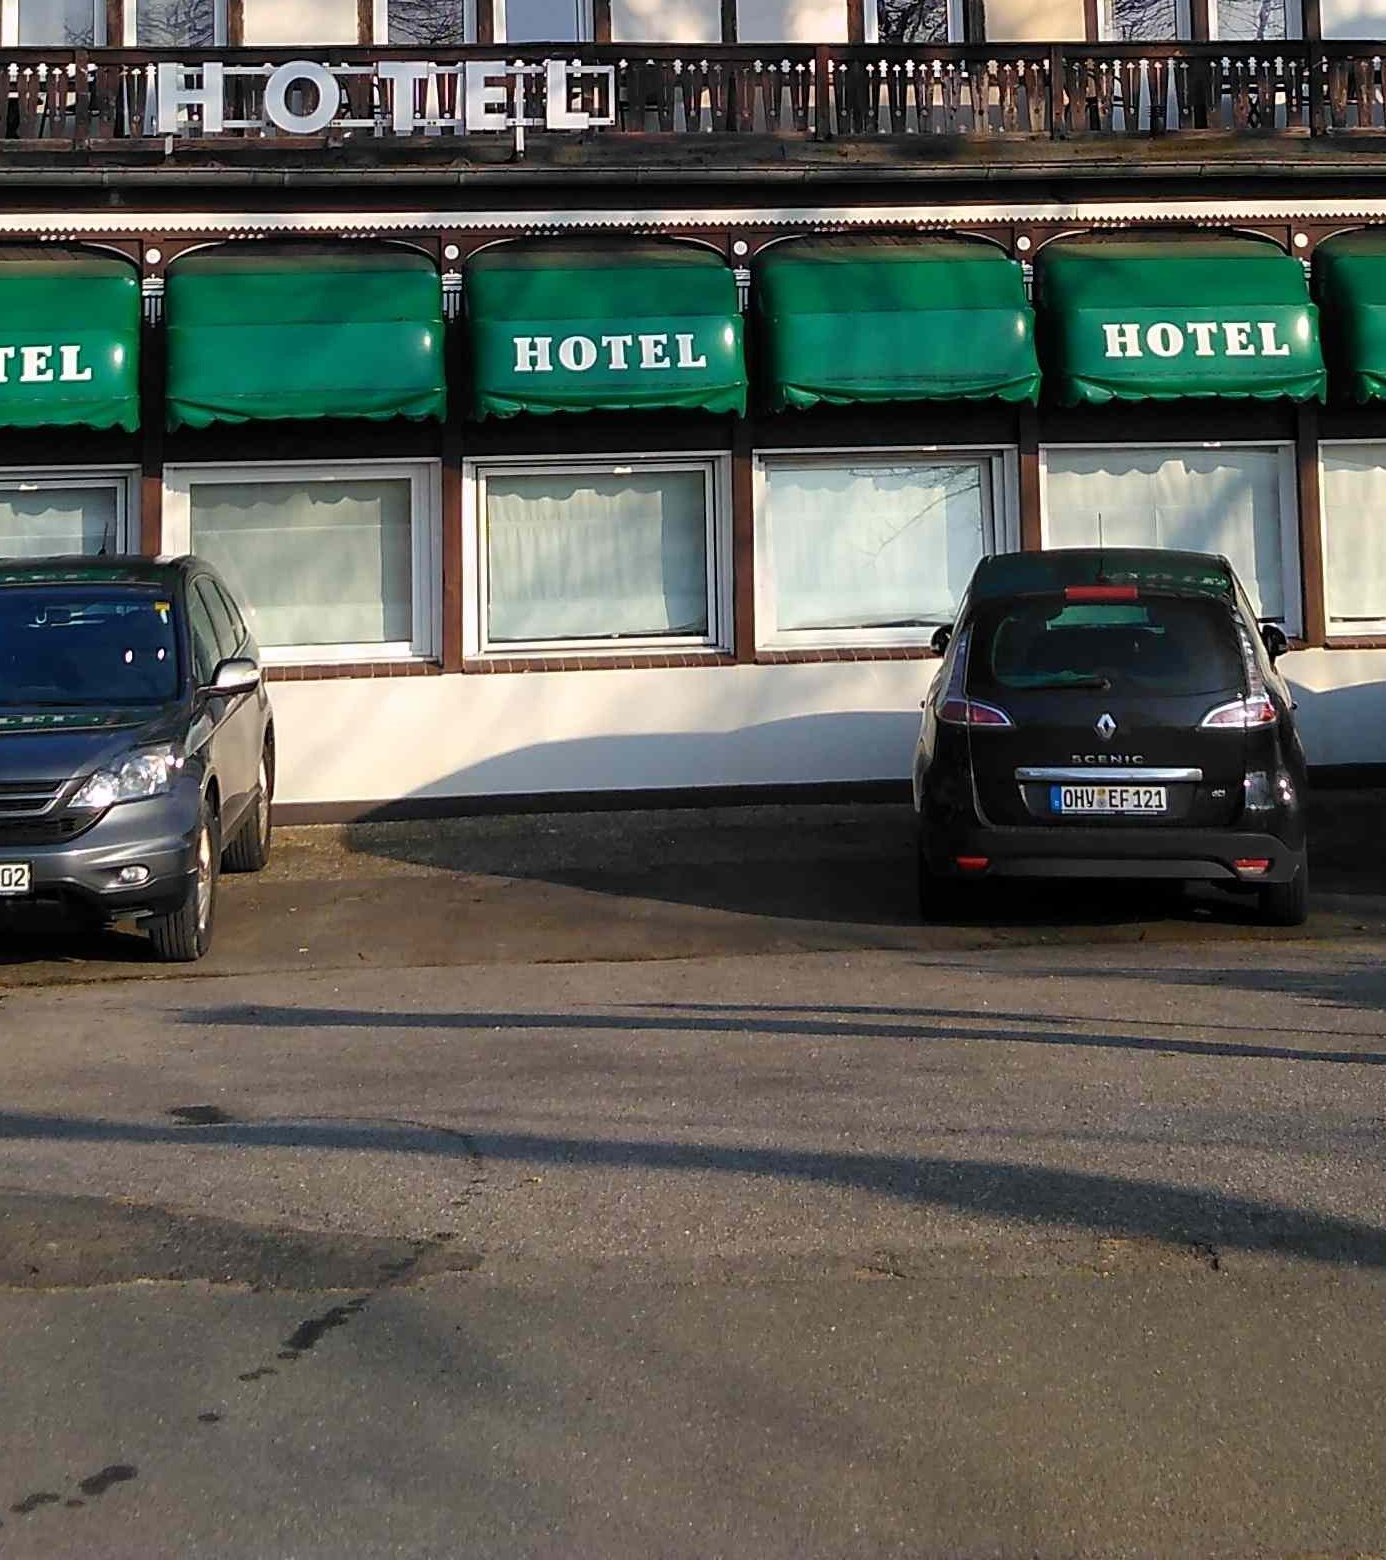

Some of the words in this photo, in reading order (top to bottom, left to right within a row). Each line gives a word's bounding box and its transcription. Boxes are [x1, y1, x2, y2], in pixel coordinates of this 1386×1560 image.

[157, 59, 591, 134] HOTEL
[513, 333, 707, 372] HOTEL
[1102, 321, 1291, 358] HOTEL
[1071, 754, 1145, 764] SCENIC
[1063, 789, 1095, 808] OHV
